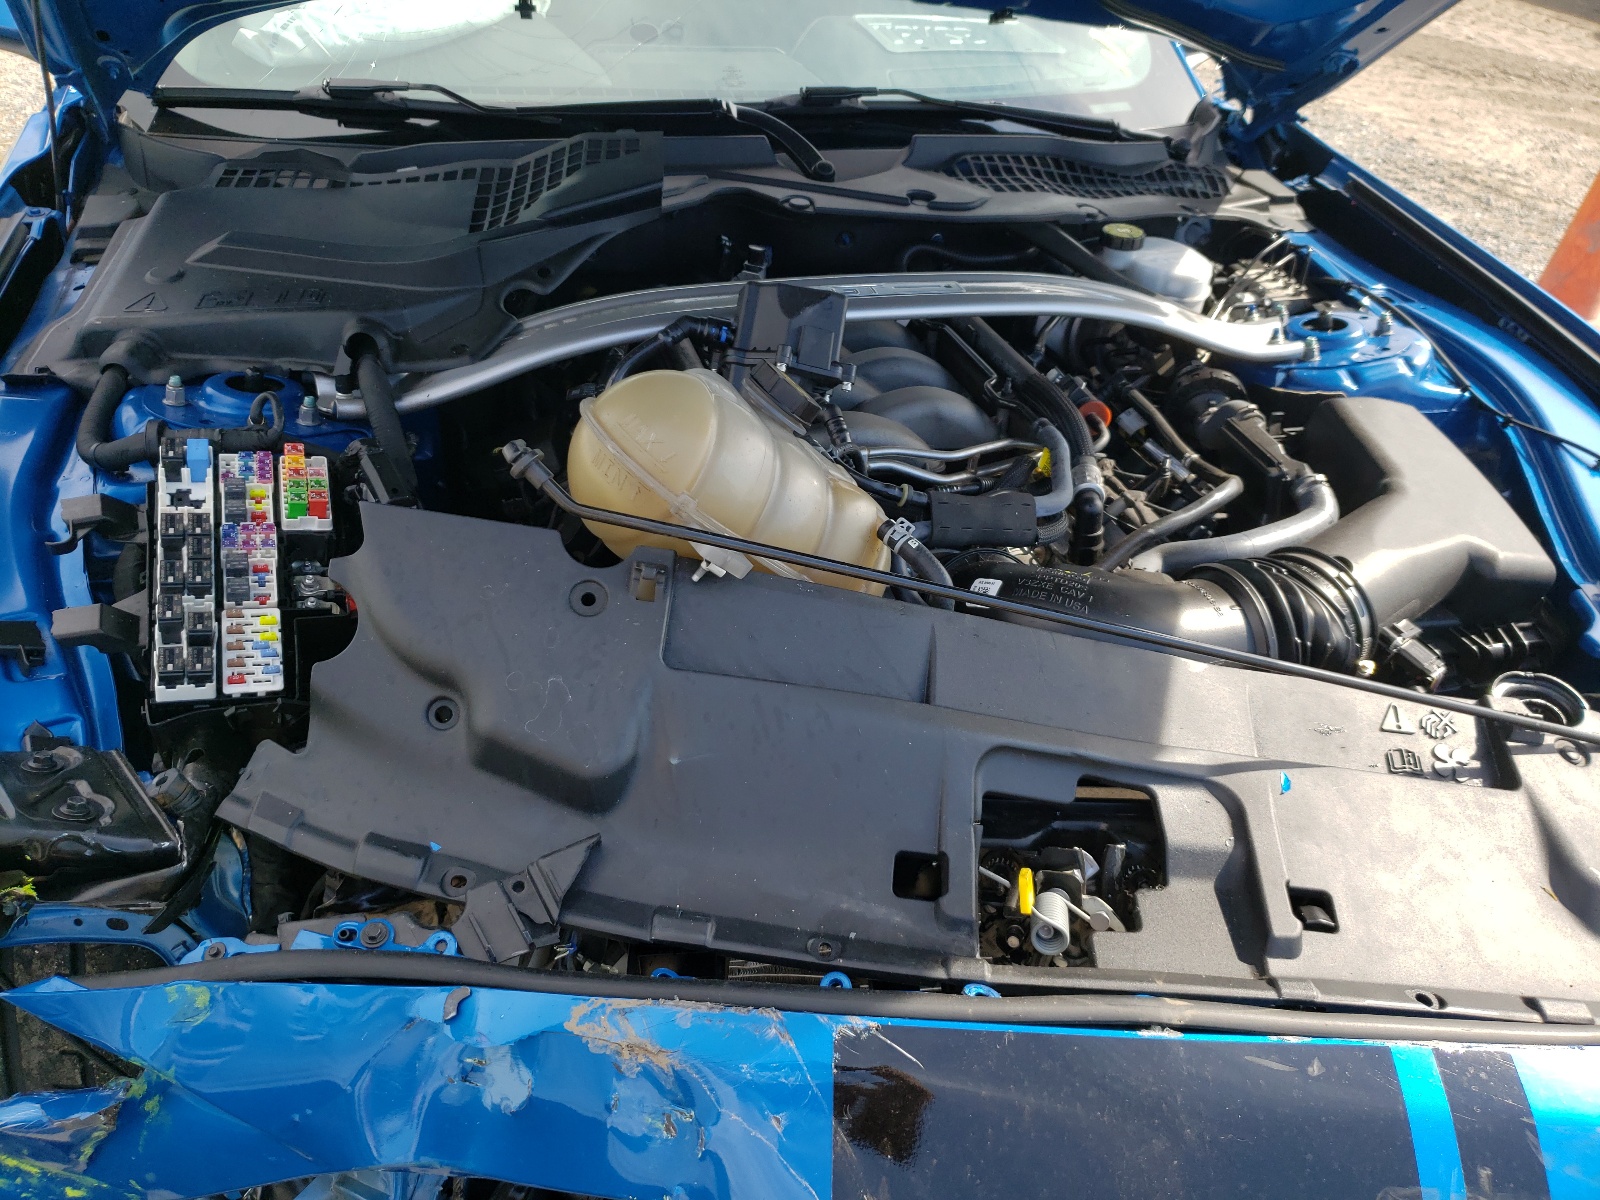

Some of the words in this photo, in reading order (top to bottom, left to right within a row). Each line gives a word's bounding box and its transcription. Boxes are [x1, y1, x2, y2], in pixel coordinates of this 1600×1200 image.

[1012, 587, 1048, 601] MADE
[1049, 592, 1063, 604] IN
[1065, 597, 1089, 615] USA
